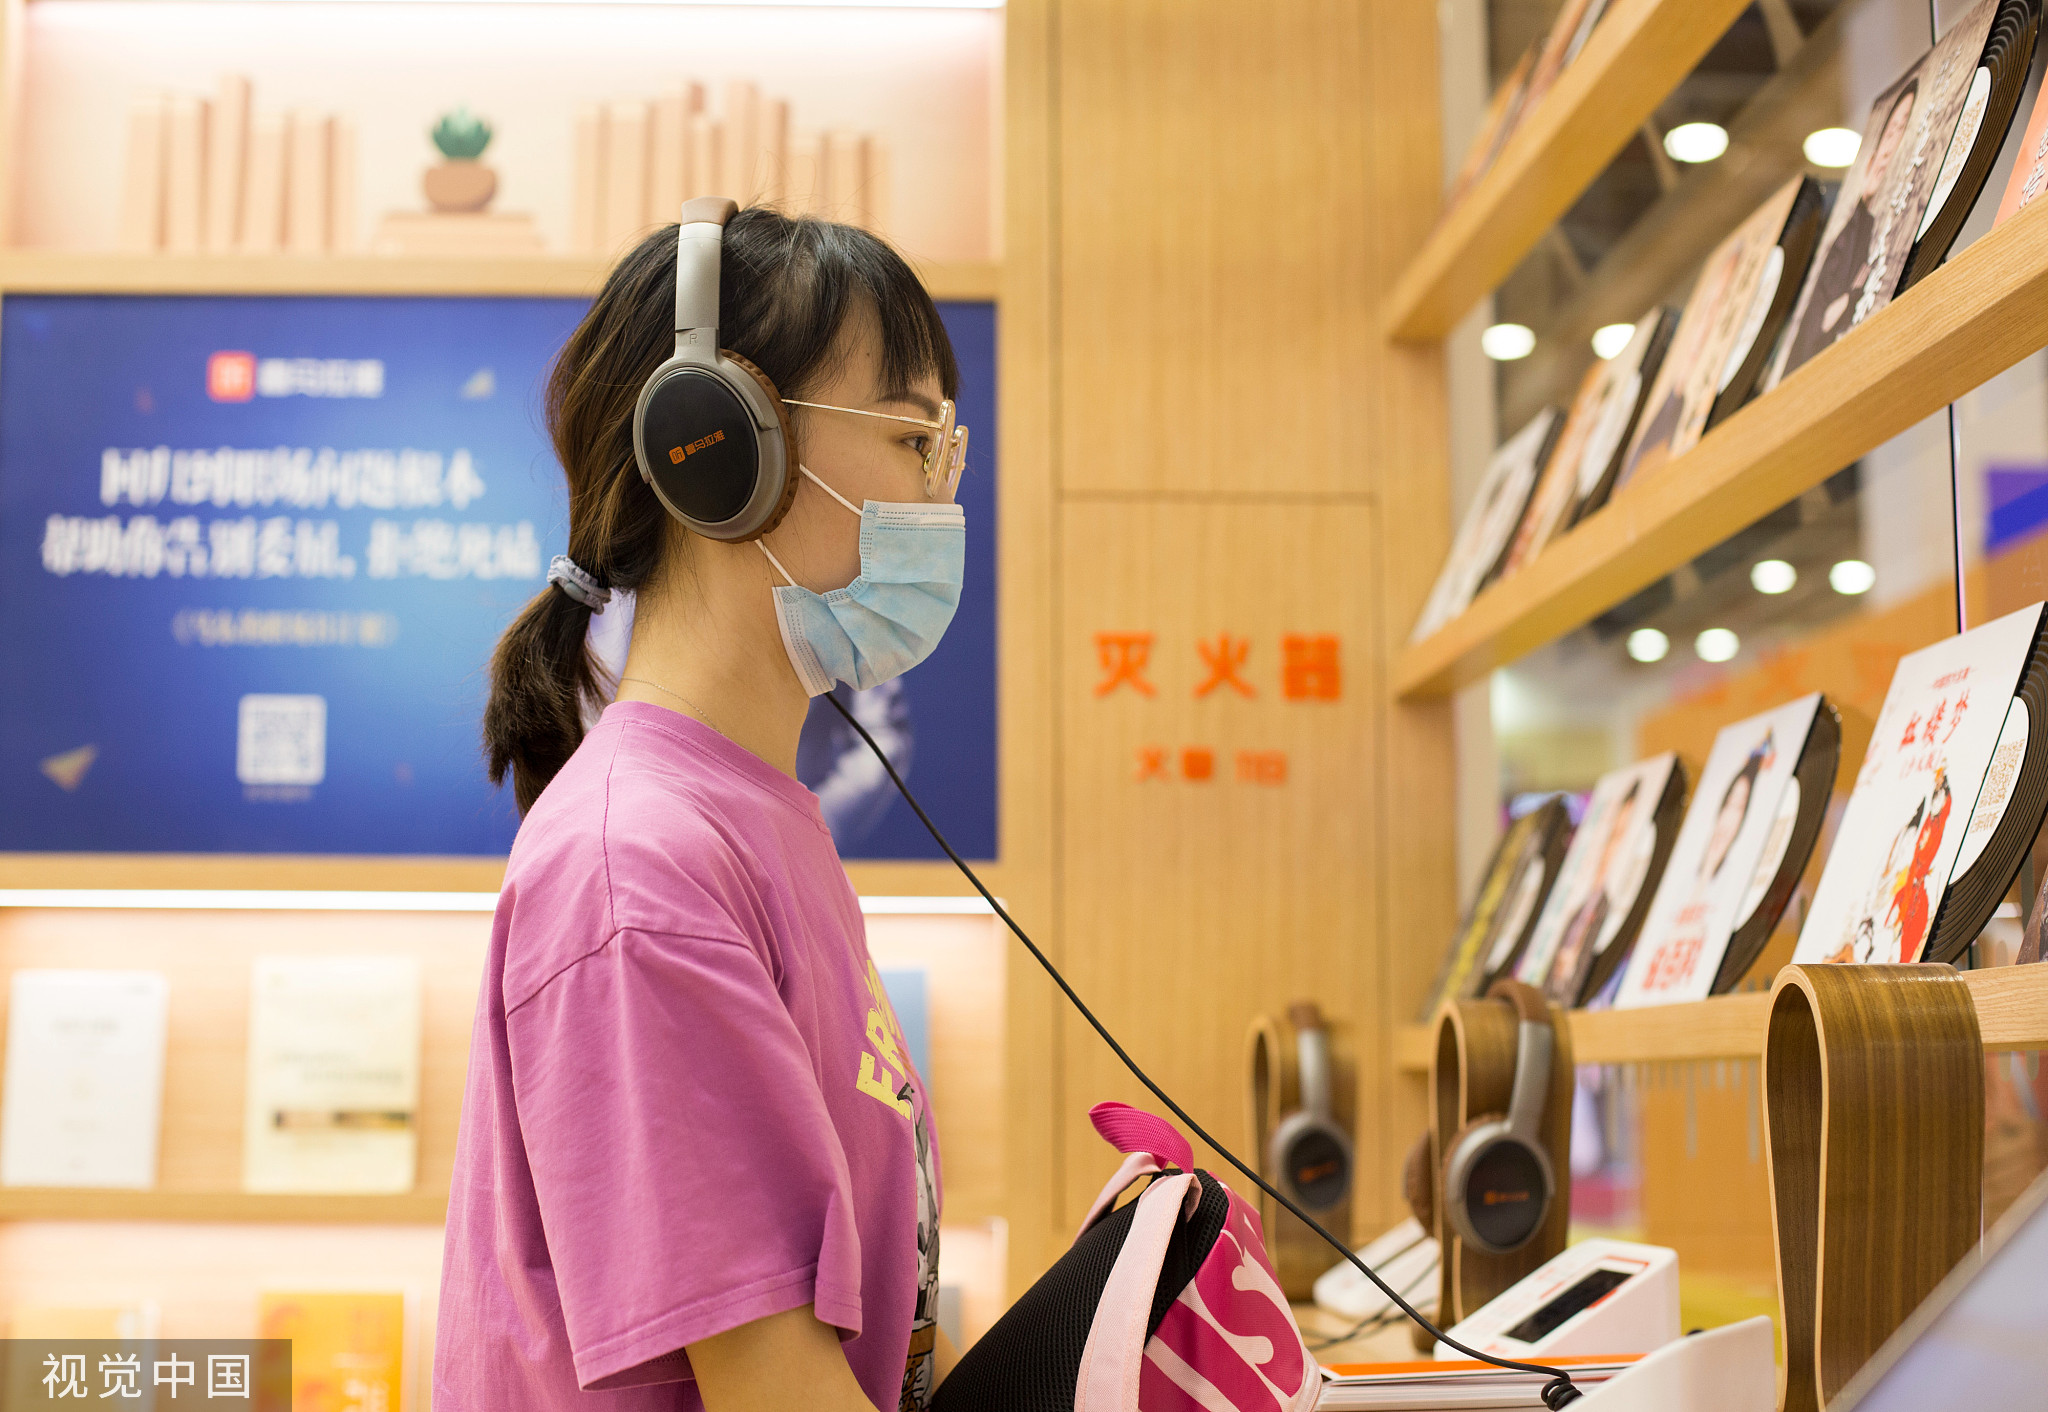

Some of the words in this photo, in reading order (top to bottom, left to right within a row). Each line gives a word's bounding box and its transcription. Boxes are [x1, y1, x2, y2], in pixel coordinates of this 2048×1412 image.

[689, 333, 698, 345] R
[1093, 630, 1342, 703] 灭火器
[1898, 688, 1969, 751] 红楼梦
